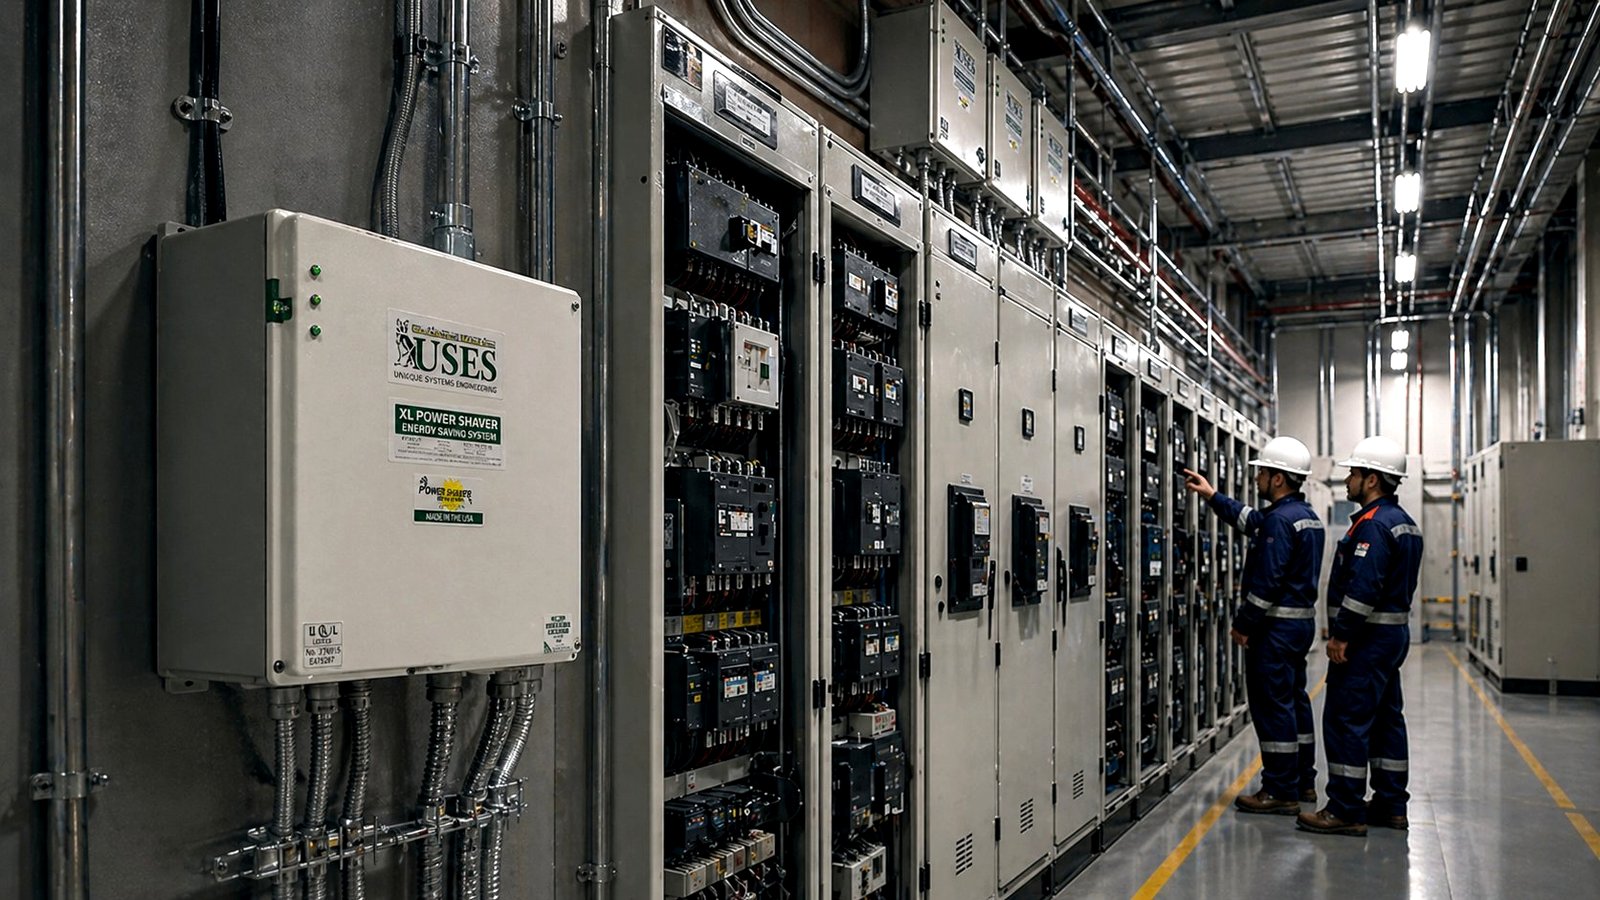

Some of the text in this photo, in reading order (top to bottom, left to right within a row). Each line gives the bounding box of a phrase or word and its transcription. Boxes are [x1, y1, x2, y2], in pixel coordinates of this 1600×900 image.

[413, 336, 497, 381] USES
[393, 370, 498, 394] UNIQUE SYSTEMS ENGINEERING
[399, 408, 498, 430] XL POWER SHAVER
[402, 422, 497, 442] ENERGY SAVING SYSTEM
[418, 485, 446, 496] POWER
